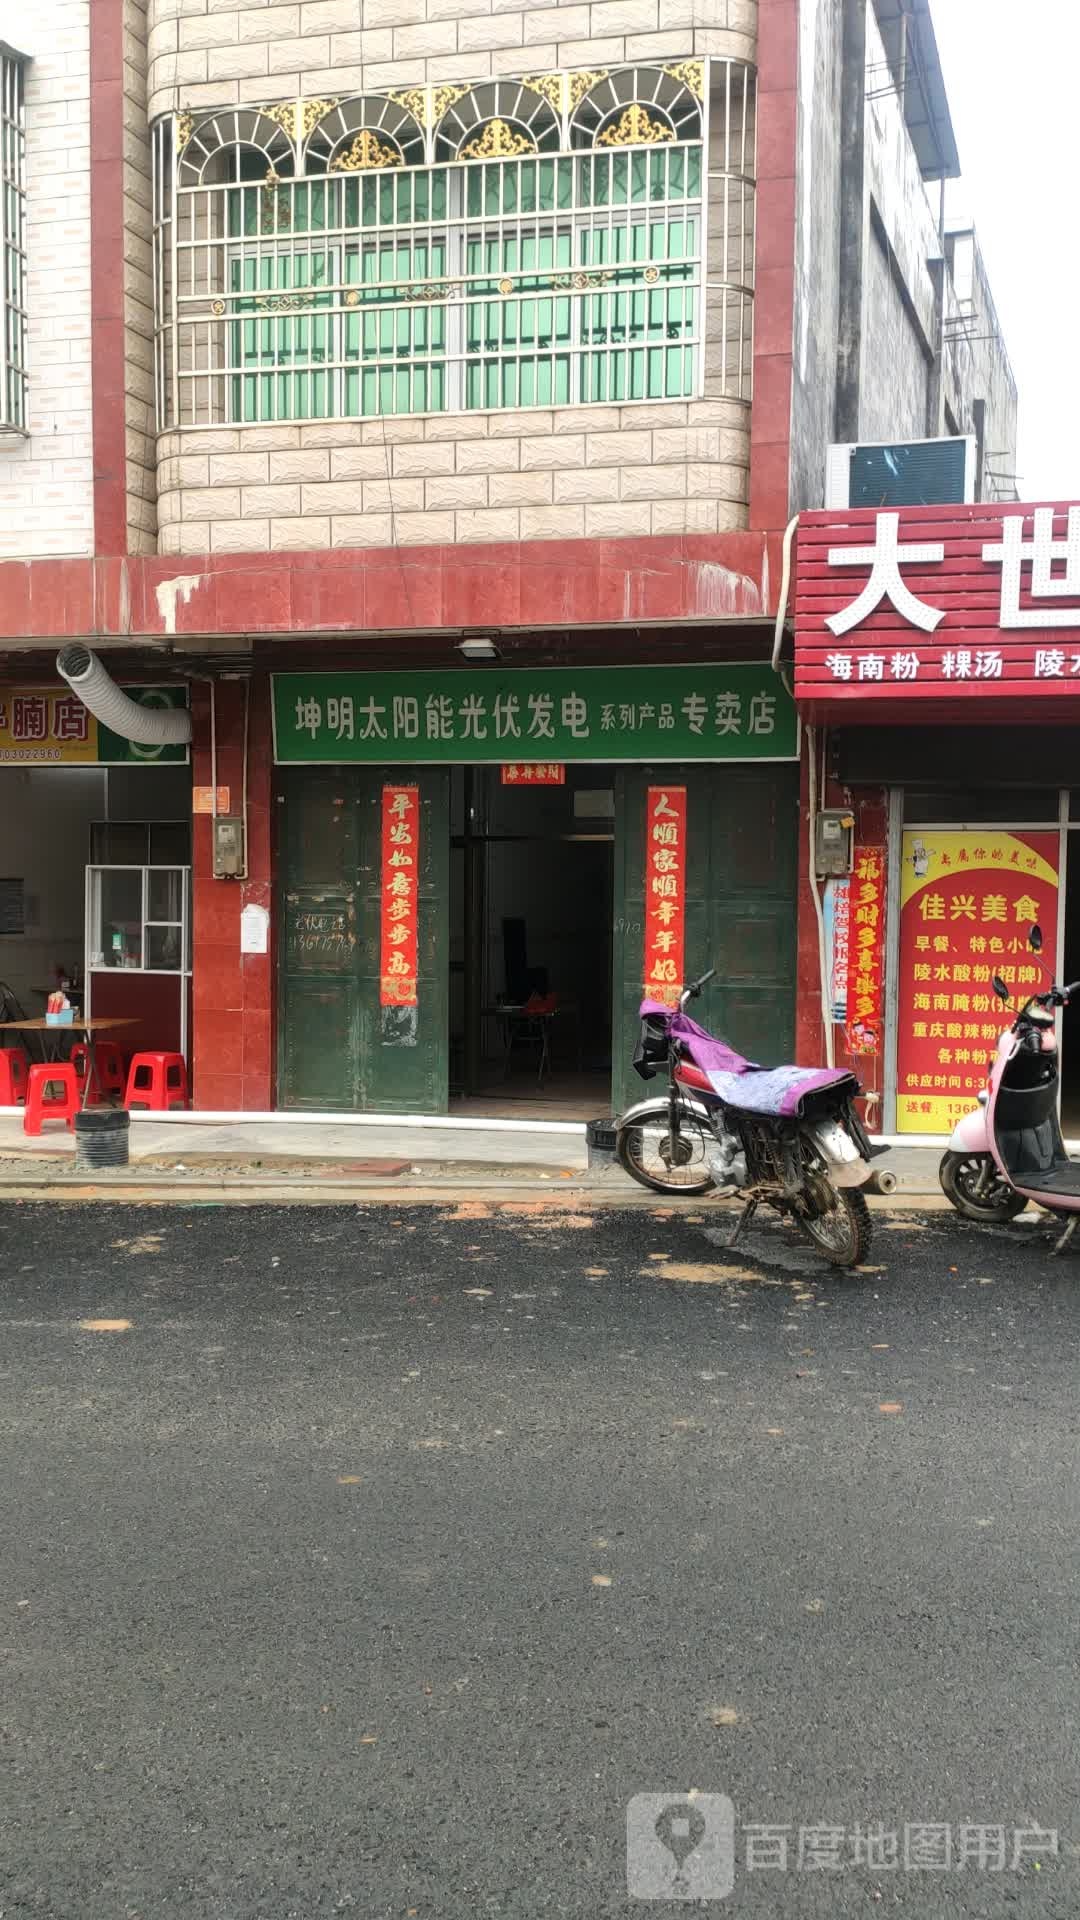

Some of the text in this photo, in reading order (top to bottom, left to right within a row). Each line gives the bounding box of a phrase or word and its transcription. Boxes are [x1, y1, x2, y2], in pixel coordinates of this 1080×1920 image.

[824, 507, 1080, 636] 大世
[825, 652, 920, 681] 海南粉
[942, 650, 1002, 679] 粿汤
[0, 696, 89, 741] 腩店
[386, 793, 415, 975] 平安如意步步高
[918, 893, 1041, 923] 佳兴美食
[914, 963, 1043, 984] 陵水酸粉(招牌)
[906, 1073, 989, 1088] 供应时间 6:3
